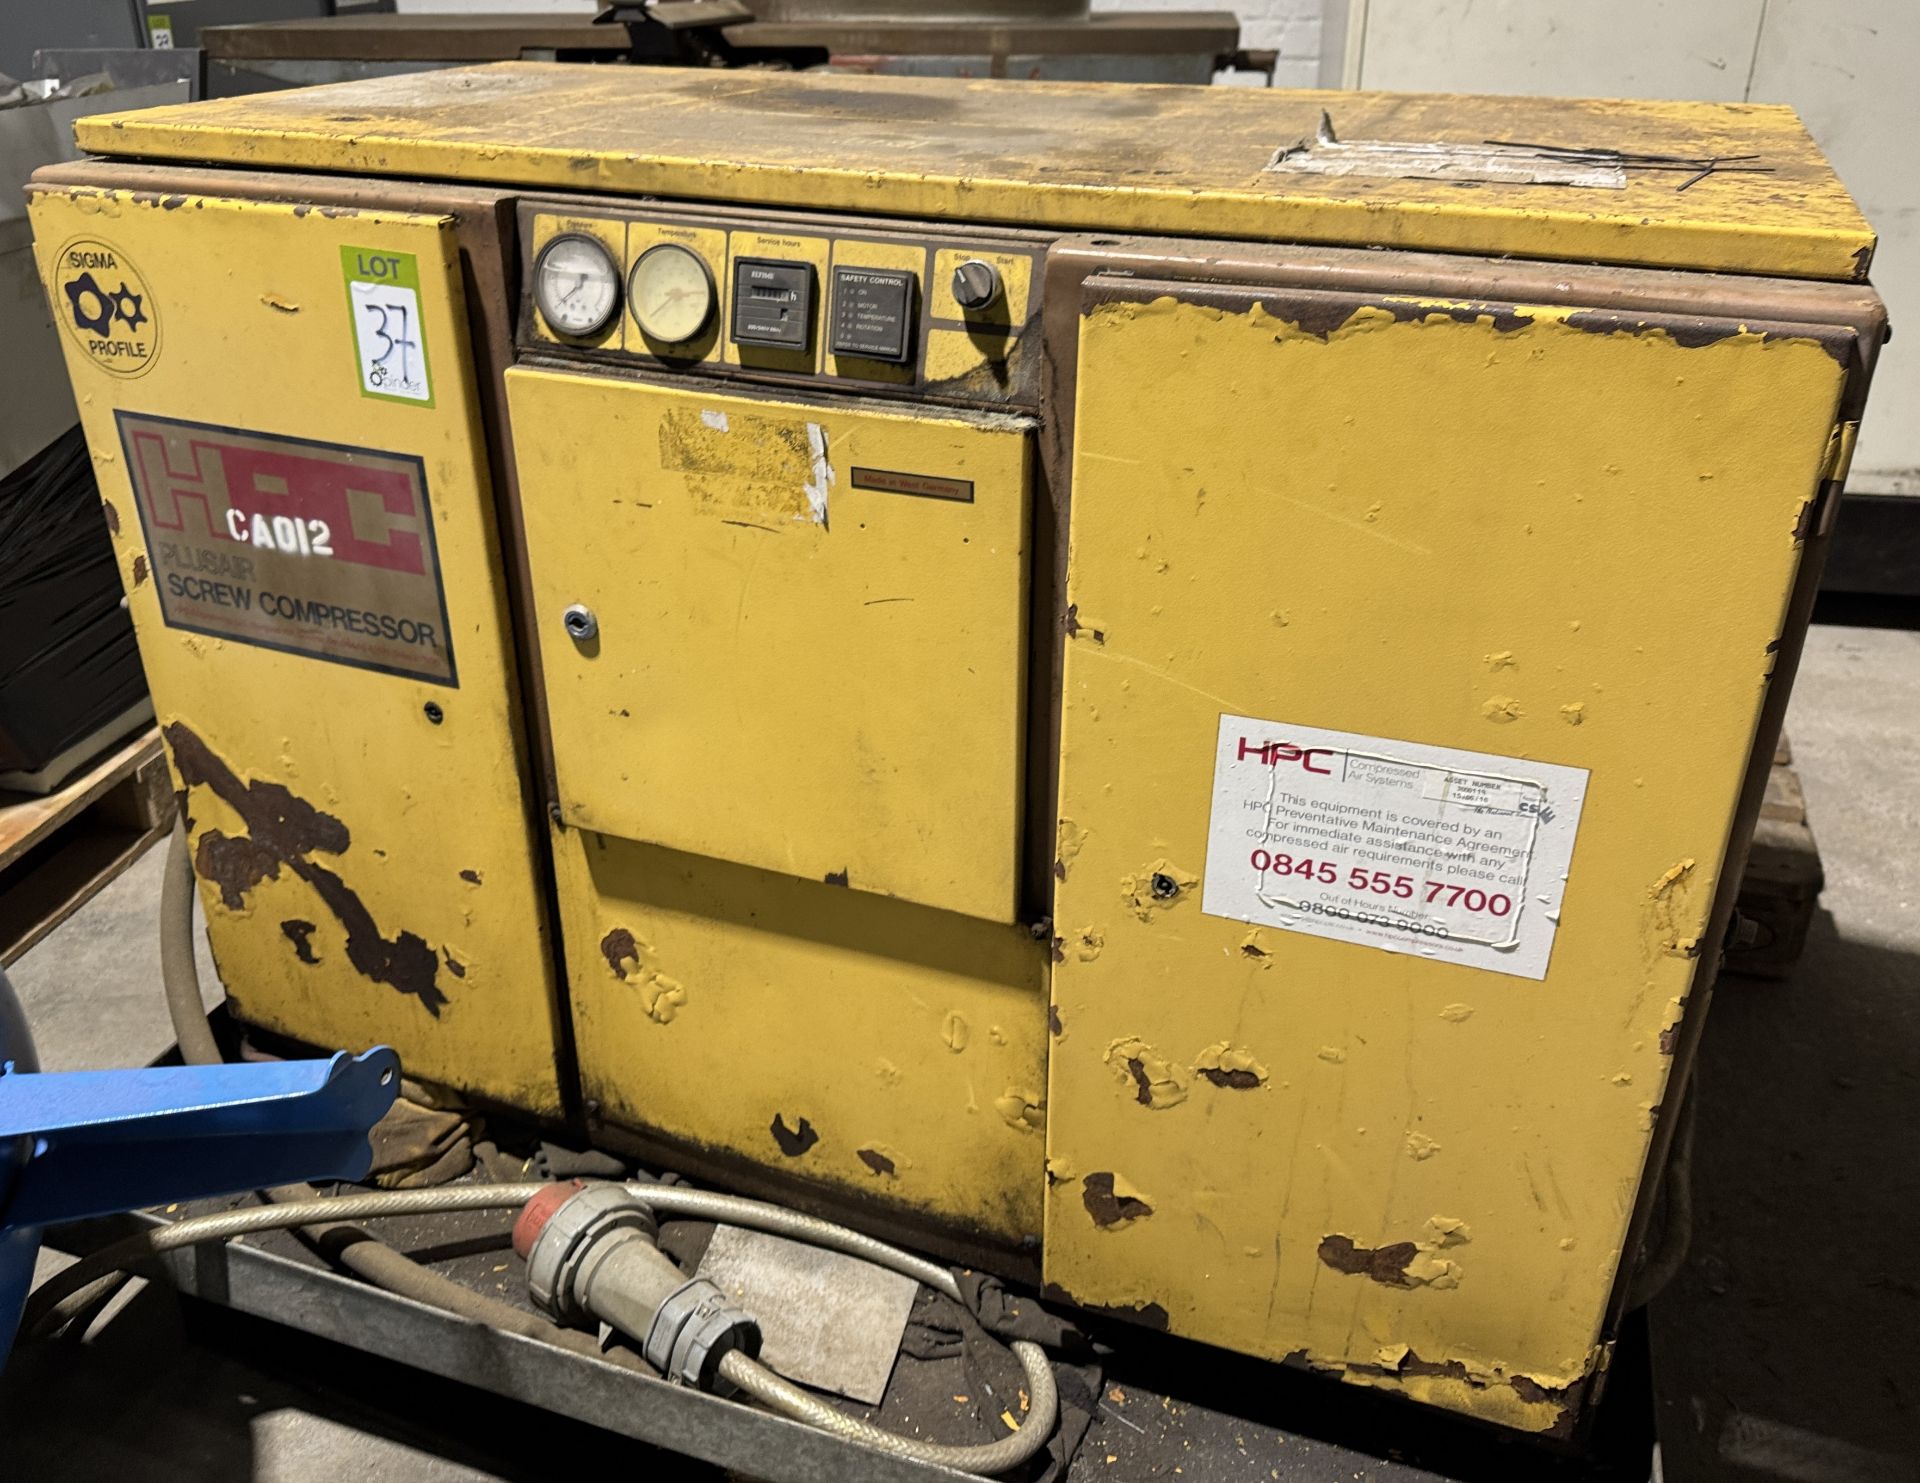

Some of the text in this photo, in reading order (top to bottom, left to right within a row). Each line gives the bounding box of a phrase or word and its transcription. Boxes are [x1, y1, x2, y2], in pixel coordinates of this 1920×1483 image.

[757, 236, 801, 248] Service hours
[69, 251, 118, 270] SIGMA
[357, 254, 400, 280] LOT
[840, 273, 904, 287] SAFETY CONTROL
[790, 291, 797, 302] h
[857, 302, 878, 310] MOTOR
[857, 312, 896, 323] TEMPERATURE
[88, 340, 148, 358] PROFILE
[365, 304, 416, 383] 37
[922, 482, 959, 496] Germany
[226, 508, 334, 556] CA012
[159, 542, 256, 581] PLUSAIR
[168, 572, 250, 610] SCREW
[259, 591, 438, 648] COMPRESSOR
[1238, 736, 1334, 775] HPC
[1350, 759, 1420, 779] Compressed
[1349, 770, 1414, 789] Air Systems
[1444, 776, 1468, 786] ASSET
[1275, 805, 1359, 829] Preventative
[1362, 820, 1453, 846] Maintenance
[1280, 792, 1503, 840] This equipment is covered by an
[1268, 817, 1506, 870] For immediate assistance with any
[1246, 828, 1524, 886] compressed air requirements please call
[1250, 848, 1512, 917] 0845 555 7700
[1319, 892, 1338, 902] Out
[1341, 896, 1352, 905] of
[1353, 899, 1385, 912] Hours
